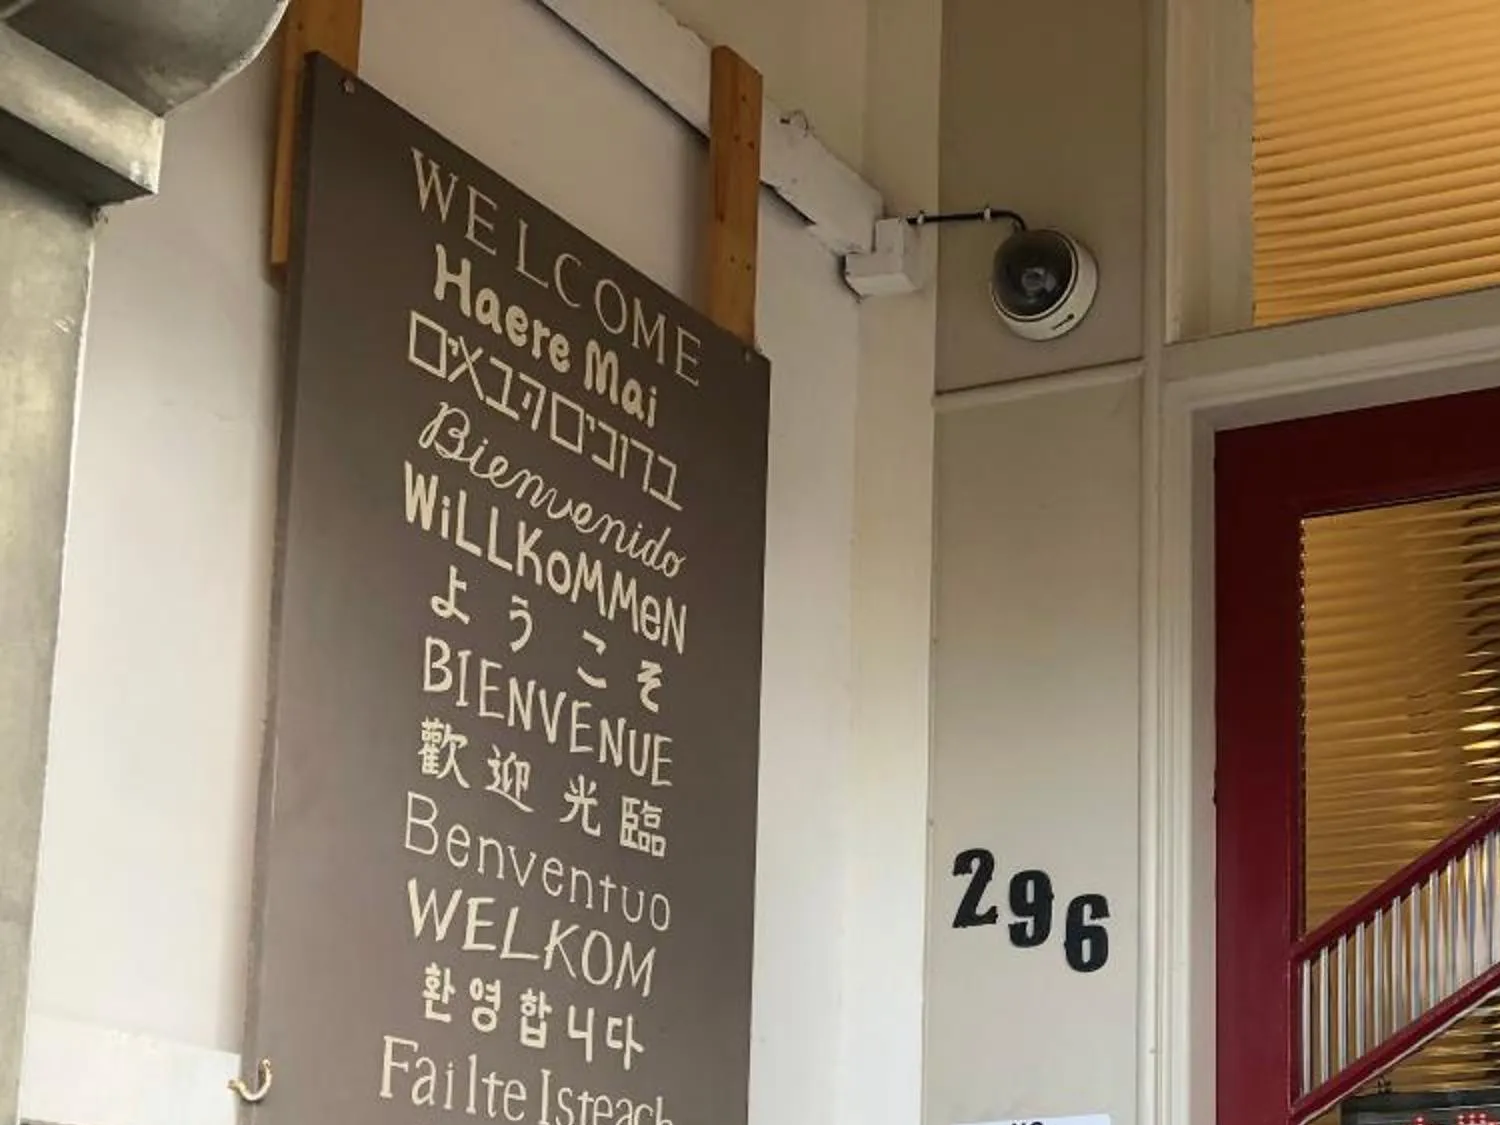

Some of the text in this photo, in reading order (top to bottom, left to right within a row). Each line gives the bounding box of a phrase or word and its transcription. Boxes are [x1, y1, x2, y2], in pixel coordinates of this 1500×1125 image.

[410, 147, 701, 387] WELCOME
[433, 244, 657, 428] Haere Mai
[418, 401, 686, 578] Bienvenido
[430, 565, 663, 712] ようこそ
[423, 636, 673, 787] BIENVENUE
[417, 716, 667, 857] 歡迎光臨
[404, 791, 671, 931] Benventuo
[951, 848, 1110, 973] 296
[407, 877, 656, 997] WELKOM
[379, 1035, 528, 1122] Failte
[422, 961, 645, 1070] 환영합니다
